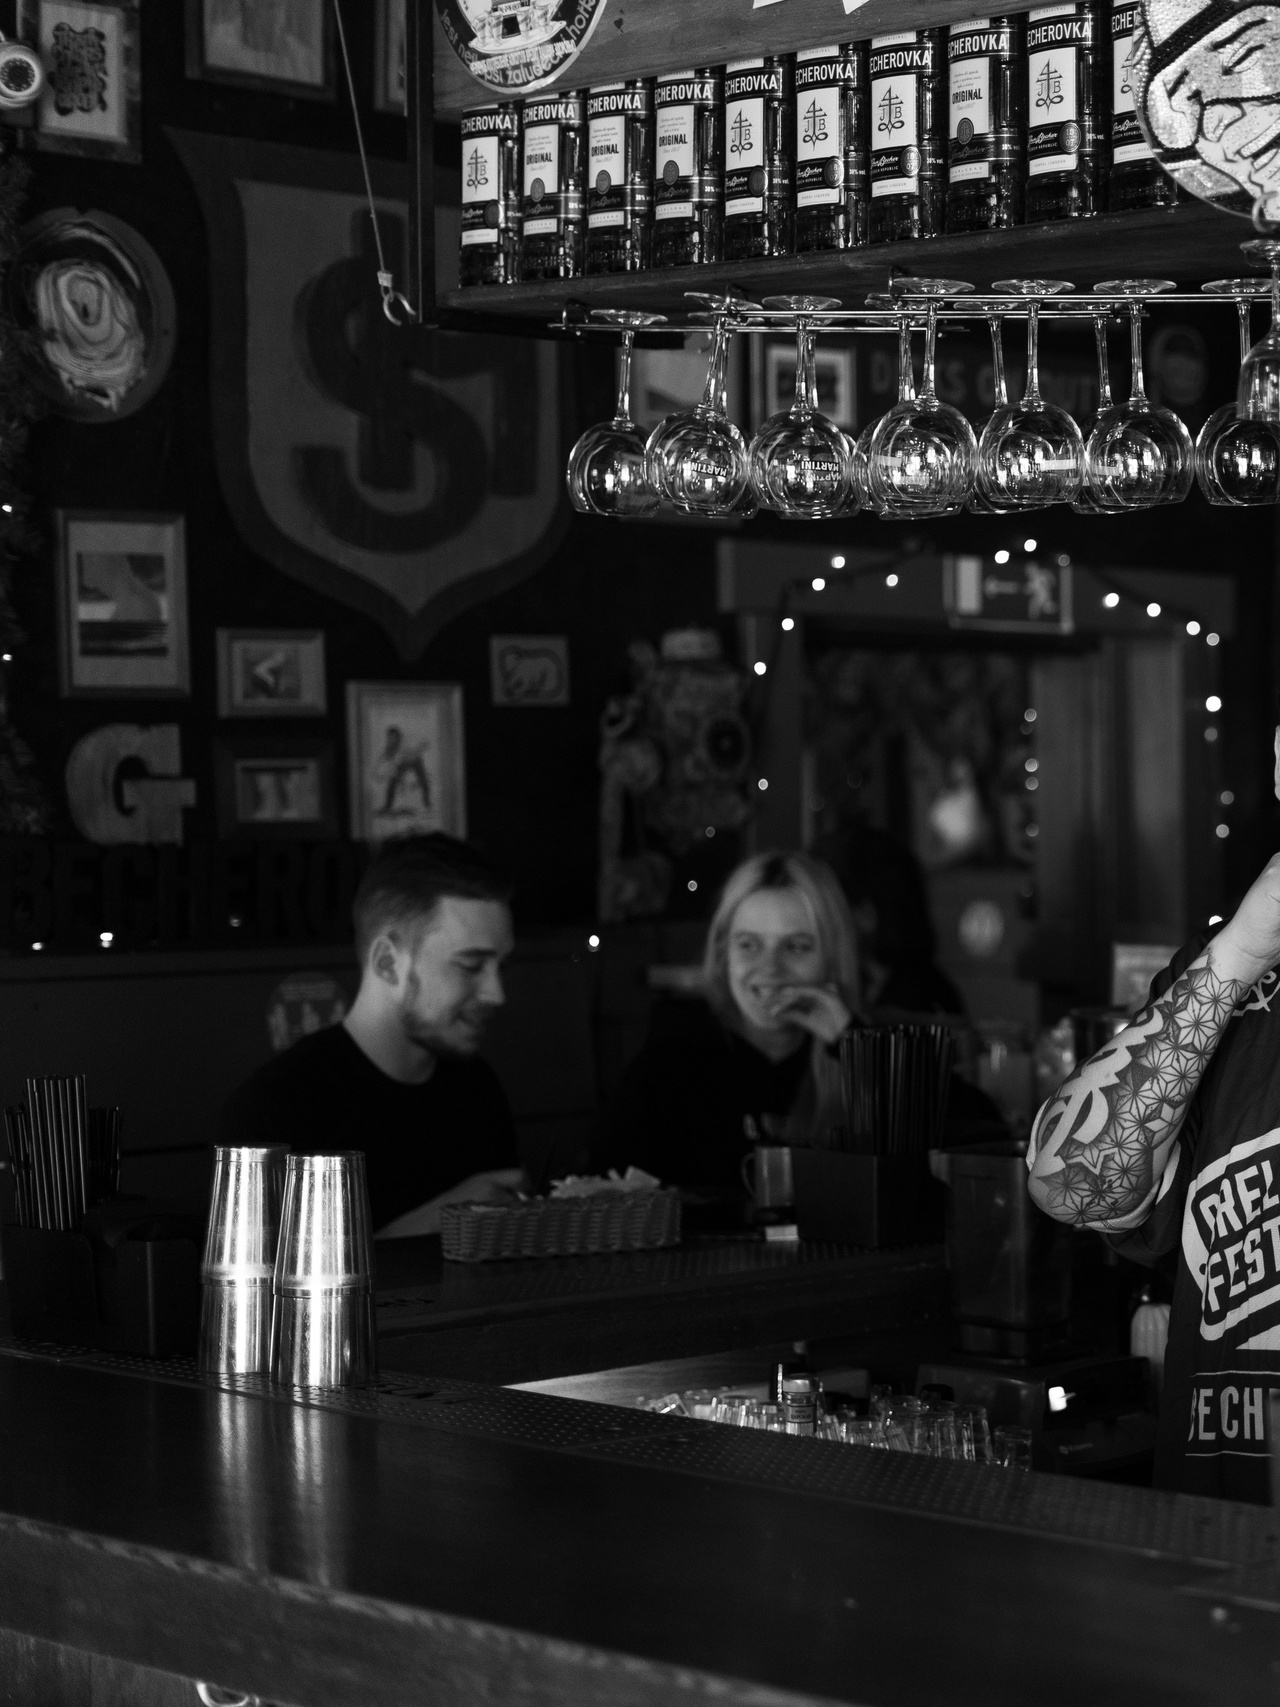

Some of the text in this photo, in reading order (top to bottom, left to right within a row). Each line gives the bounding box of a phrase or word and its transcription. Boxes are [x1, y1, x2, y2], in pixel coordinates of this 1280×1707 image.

[952, 88, 983, 104] ORIGINAL
[658, 133, 688, 148] ORIGINAL
[591, 143, 619, 158] ORIGINAL
[526, 152, 553, 165] ORIGINAL
